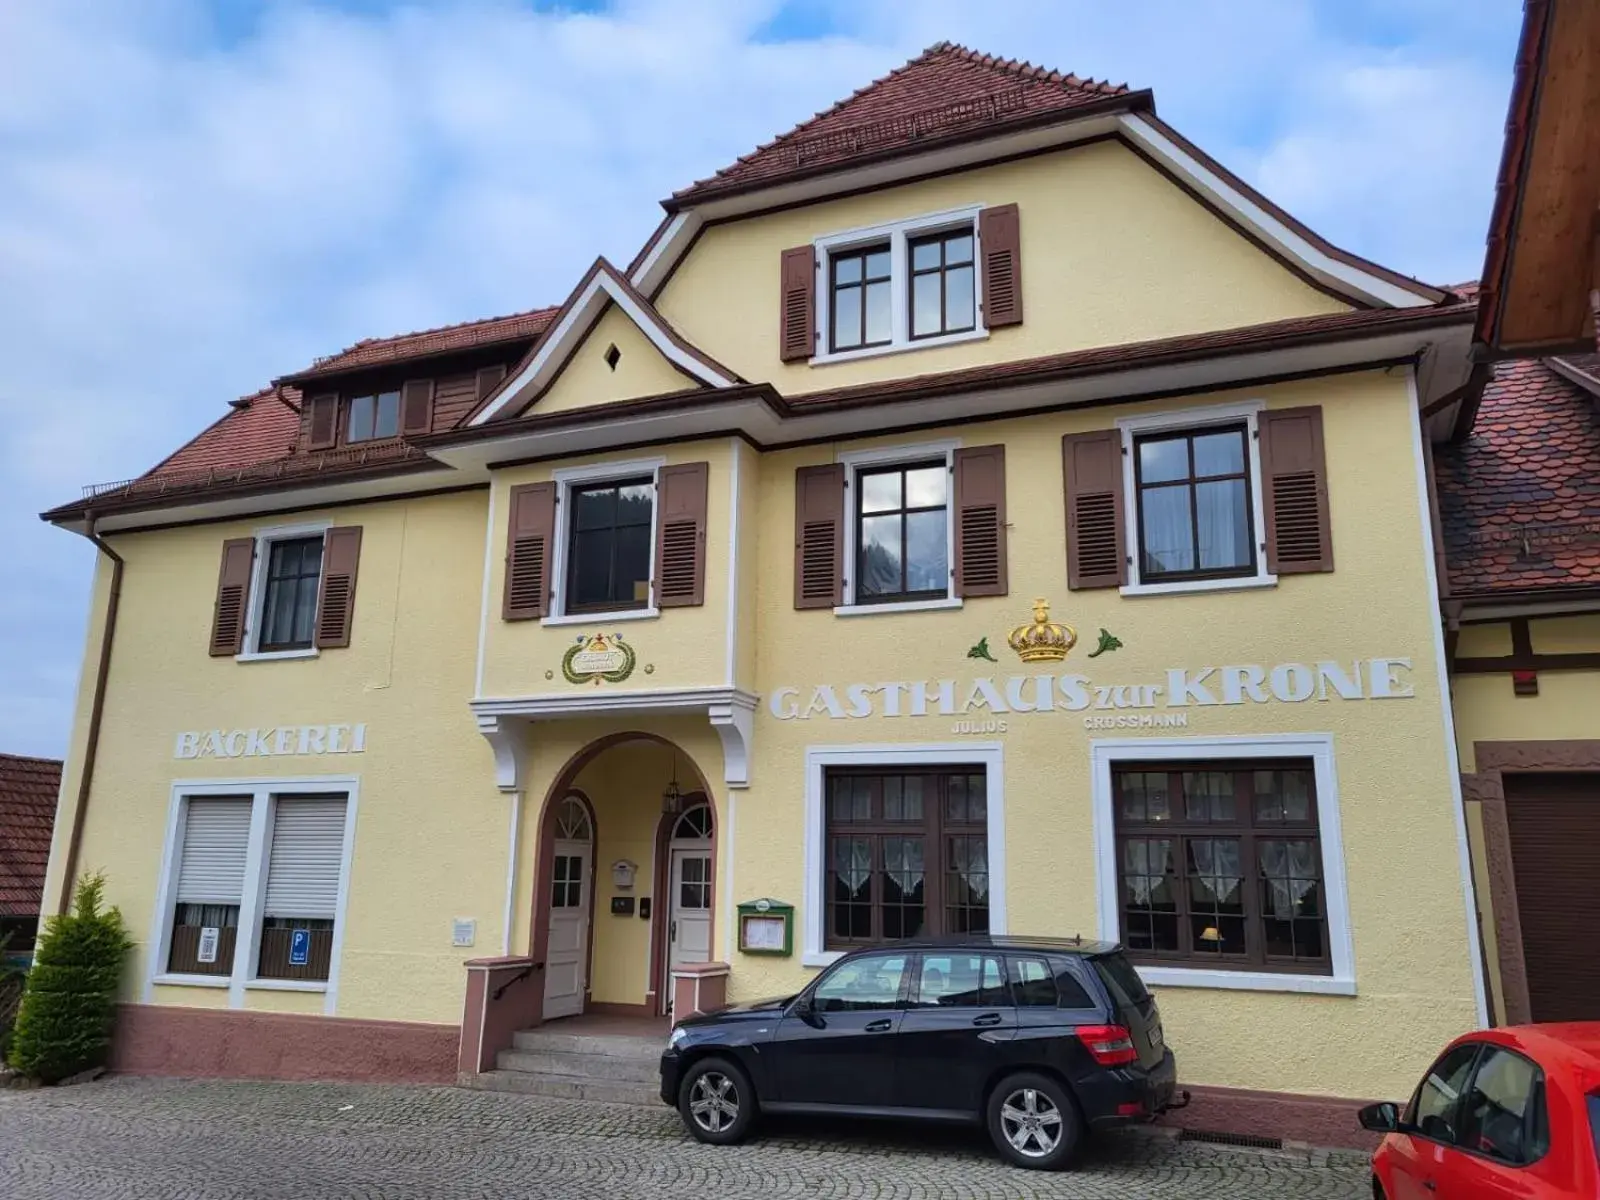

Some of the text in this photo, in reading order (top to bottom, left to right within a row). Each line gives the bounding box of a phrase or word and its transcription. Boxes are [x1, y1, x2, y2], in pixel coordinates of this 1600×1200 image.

[769, 656, 1415, 721] GASTHAUS zur KRONE
[951, 712, 1189, 735] JULIUS GROSSMANN
[295, 933, 303, 946] P
